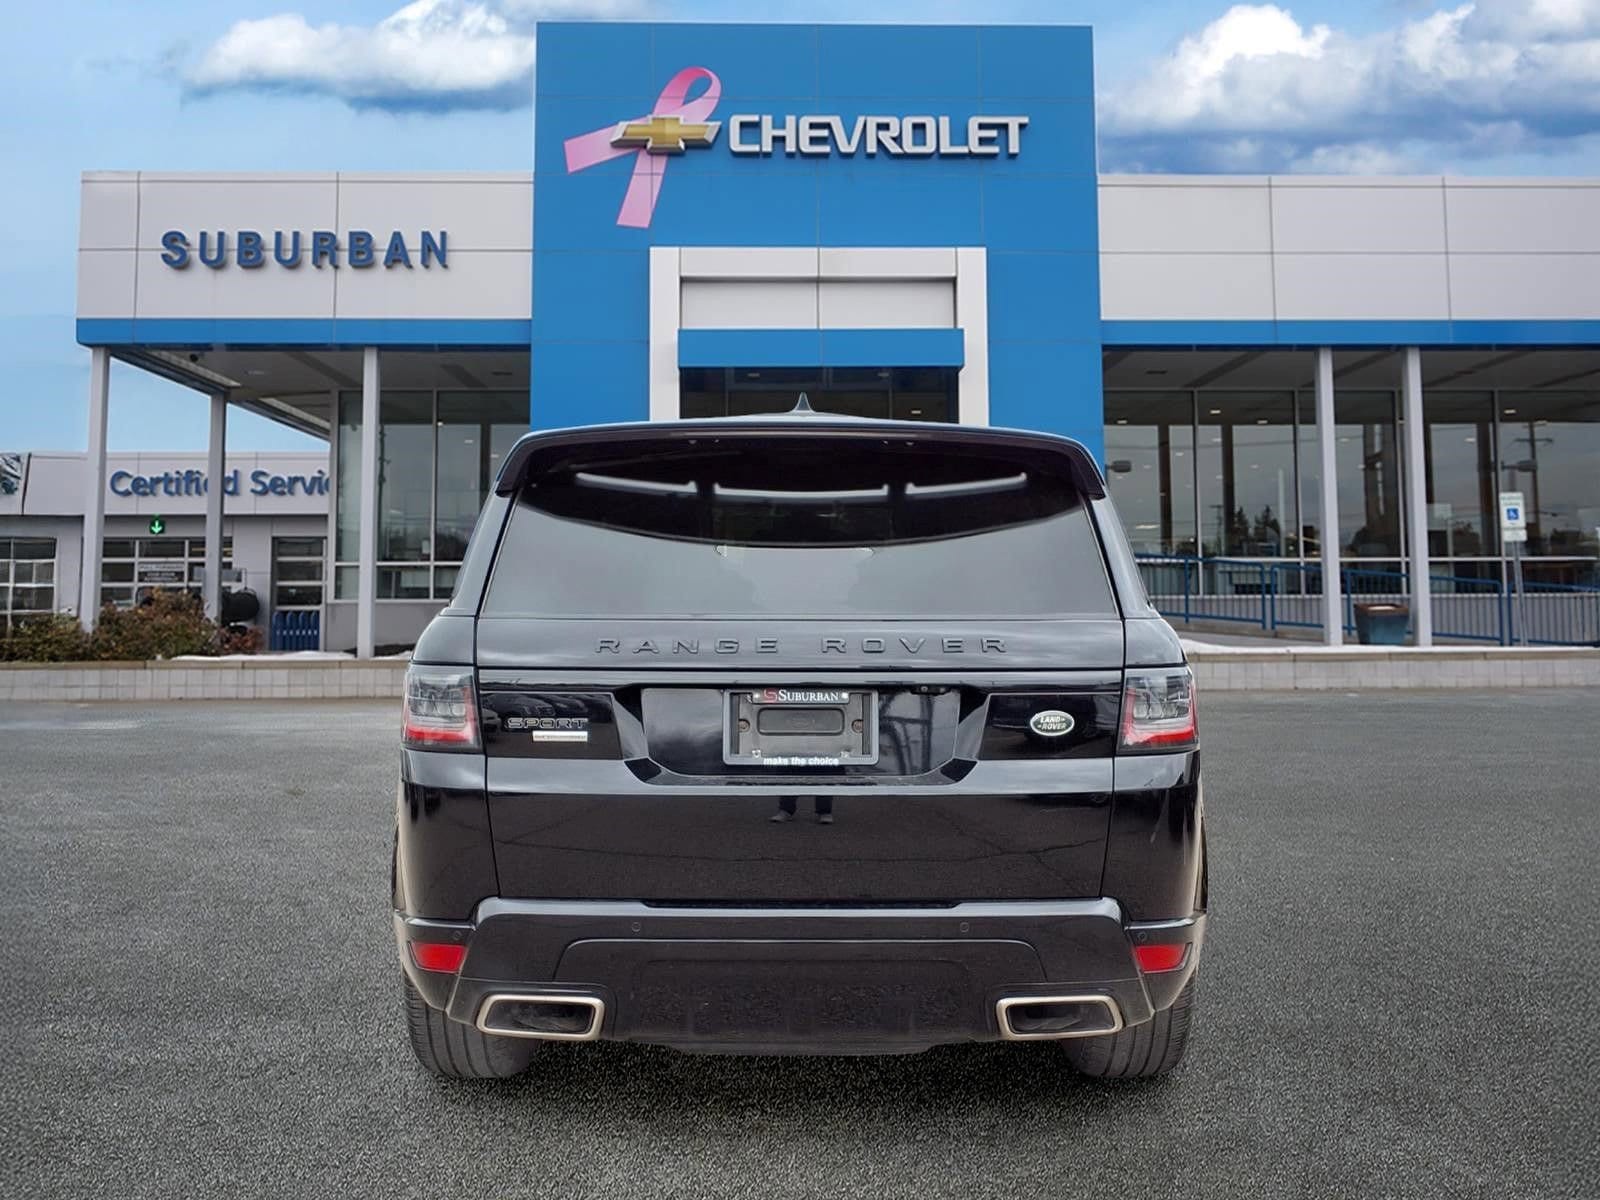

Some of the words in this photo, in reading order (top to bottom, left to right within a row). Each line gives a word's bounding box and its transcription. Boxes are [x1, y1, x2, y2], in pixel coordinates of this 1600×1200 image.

[729, 114, 1029, 156] CHEVROLET
[161, 230, 449, 269] SUBURBAN
[595, 637, 779, 655] RANGE
[821, 637, 1008, 655] ROVER
[778, 689, 839, 702] SUBURBAN
[506, 717, 589, 729] SPORT
[763, 757, 789, 765] make
[791, 757, 806, 766] the
[808, 757, 839, 766] choice
